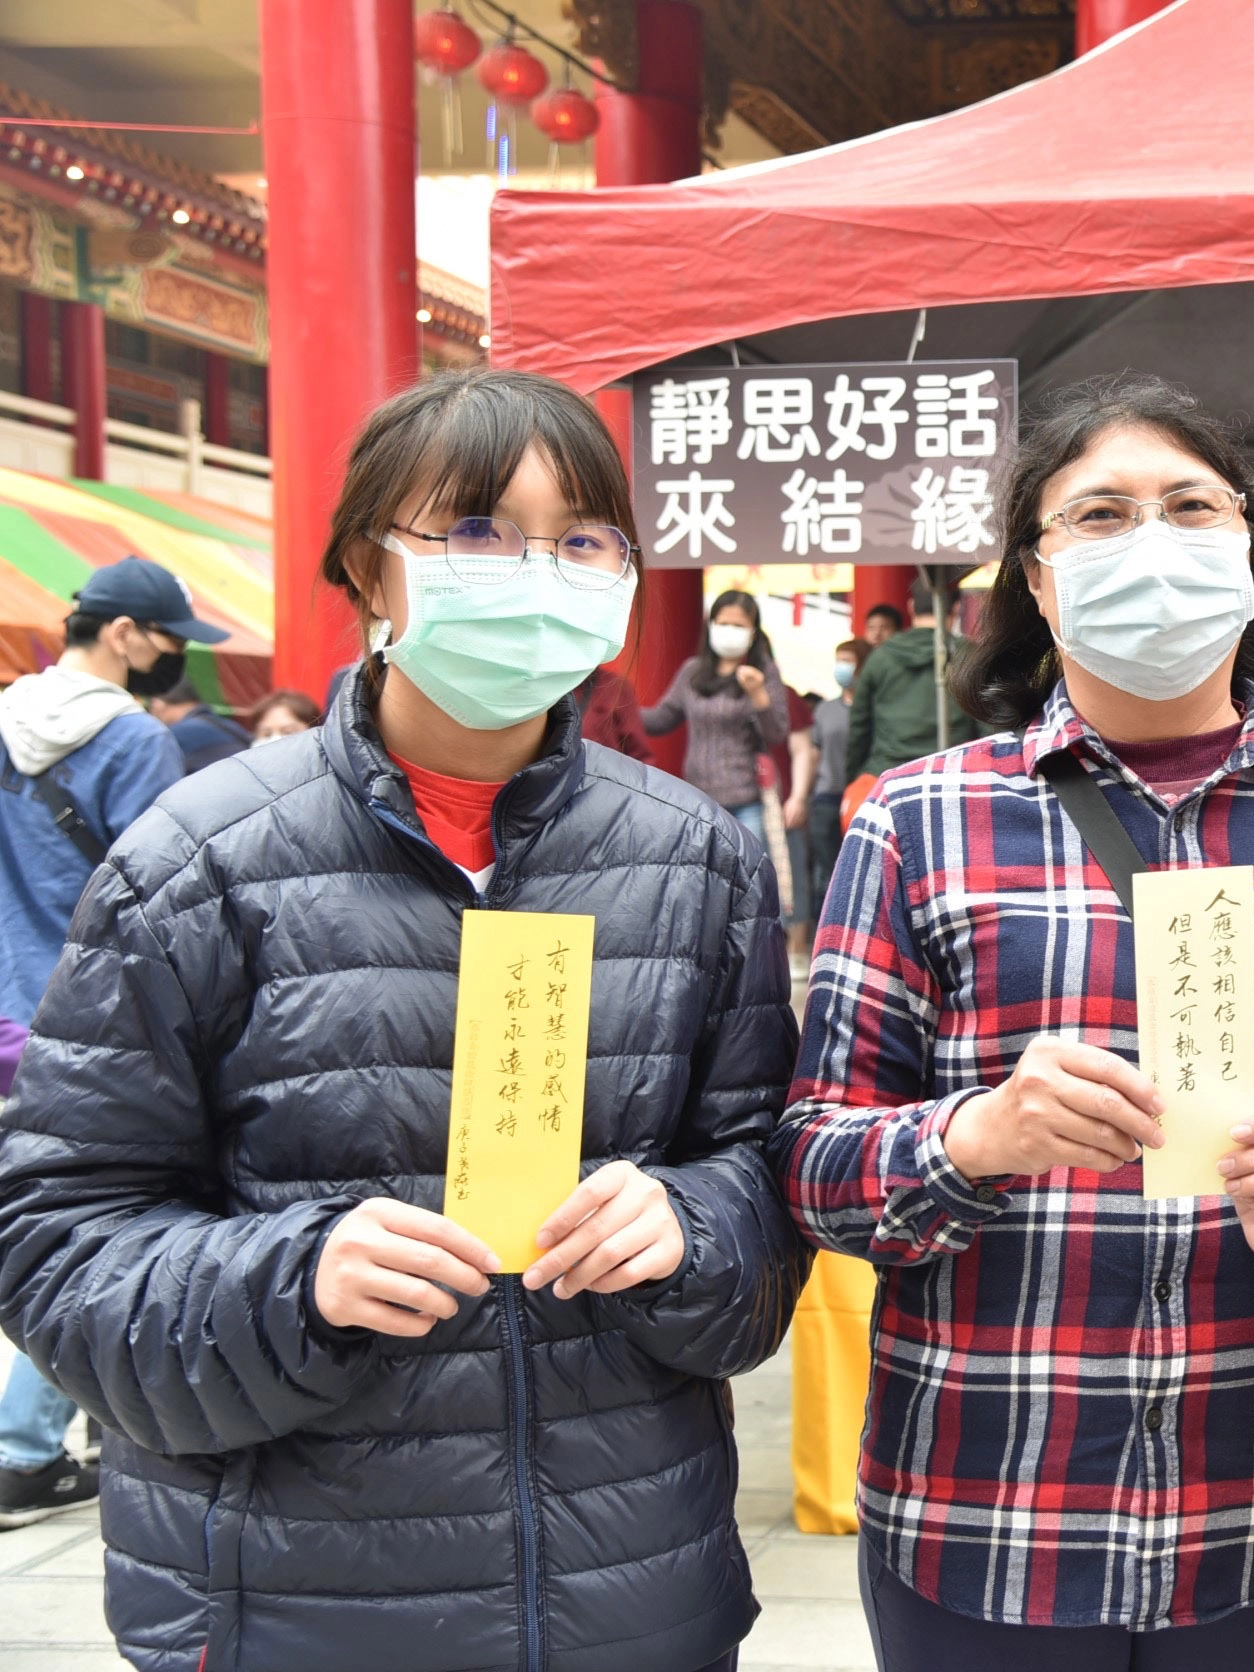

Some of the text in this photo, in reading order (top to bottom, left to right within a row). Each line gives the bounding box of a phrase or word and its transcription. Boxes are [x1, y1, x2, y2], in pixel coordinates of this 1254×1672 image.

[649, 369, 999, 465] 靜思好話
[653, 466, 997, 559] 來結緣
[494, 953, 531, 1138] 才能永遠保持
[537, 939, 570, 1133] 有智慧的感情
[1205, 888, 1241, 1082] 人應該相信自己
